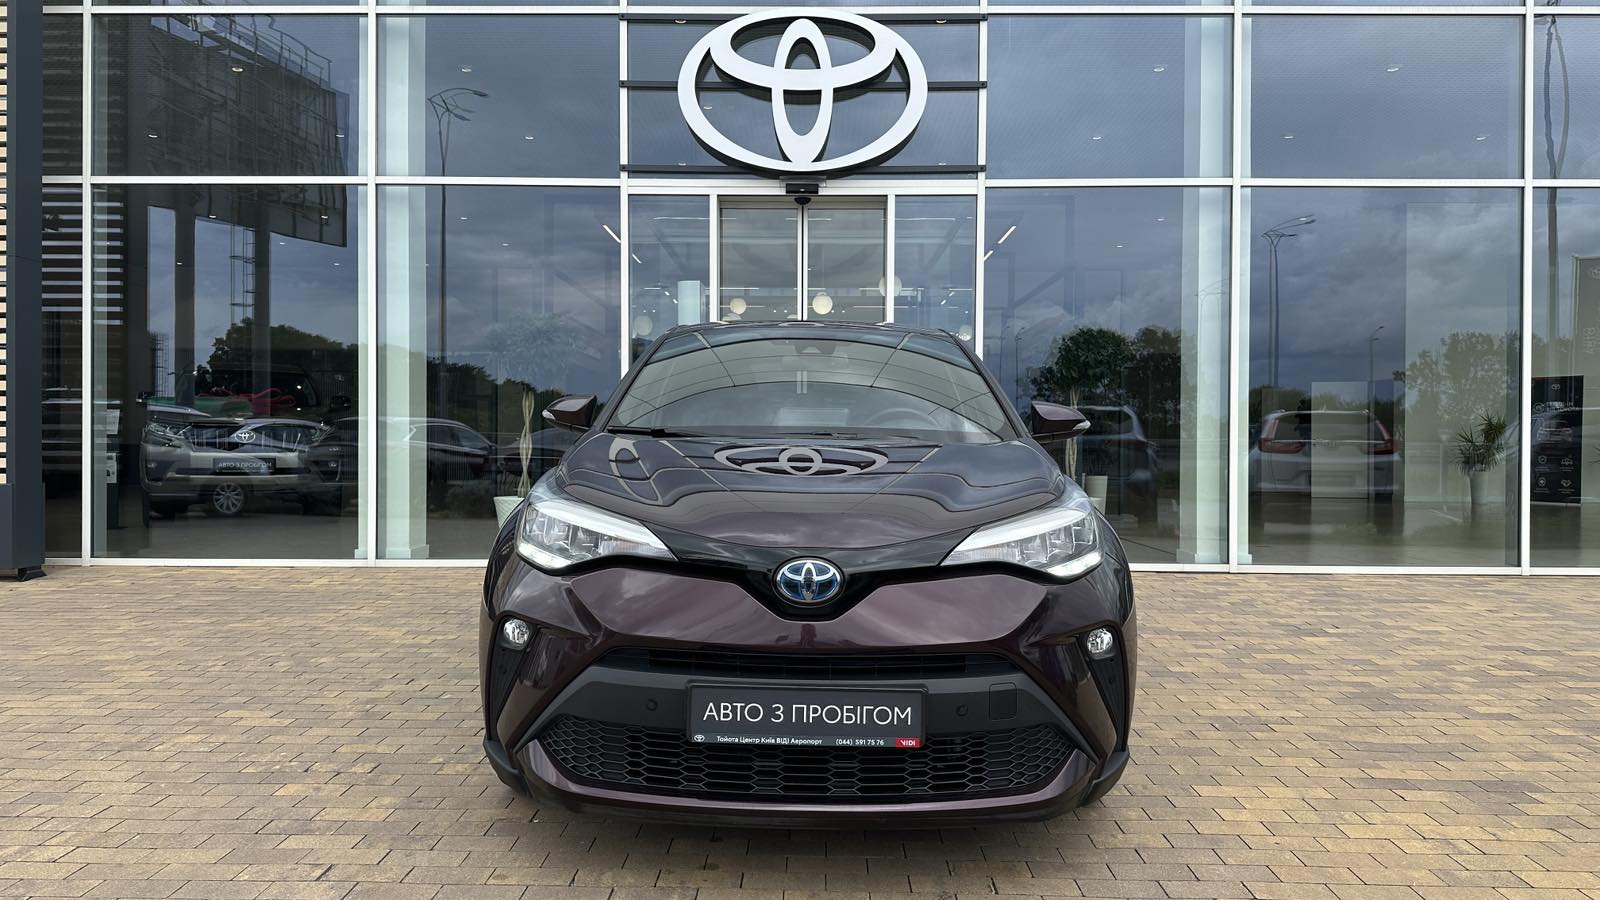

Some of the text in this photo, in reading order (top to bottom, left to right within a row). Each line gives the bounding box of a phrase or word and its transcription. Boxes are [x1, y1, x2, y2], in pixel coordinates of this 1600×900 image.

[703, 702, 763, 722] АВТО
[792, 704, 911, 726] ПРОБІГОМ
[717, 735, 739, 743] Тойота
[739, 736, 760, 744] Центр
[790, 738, 822, 746] Аеропорт
